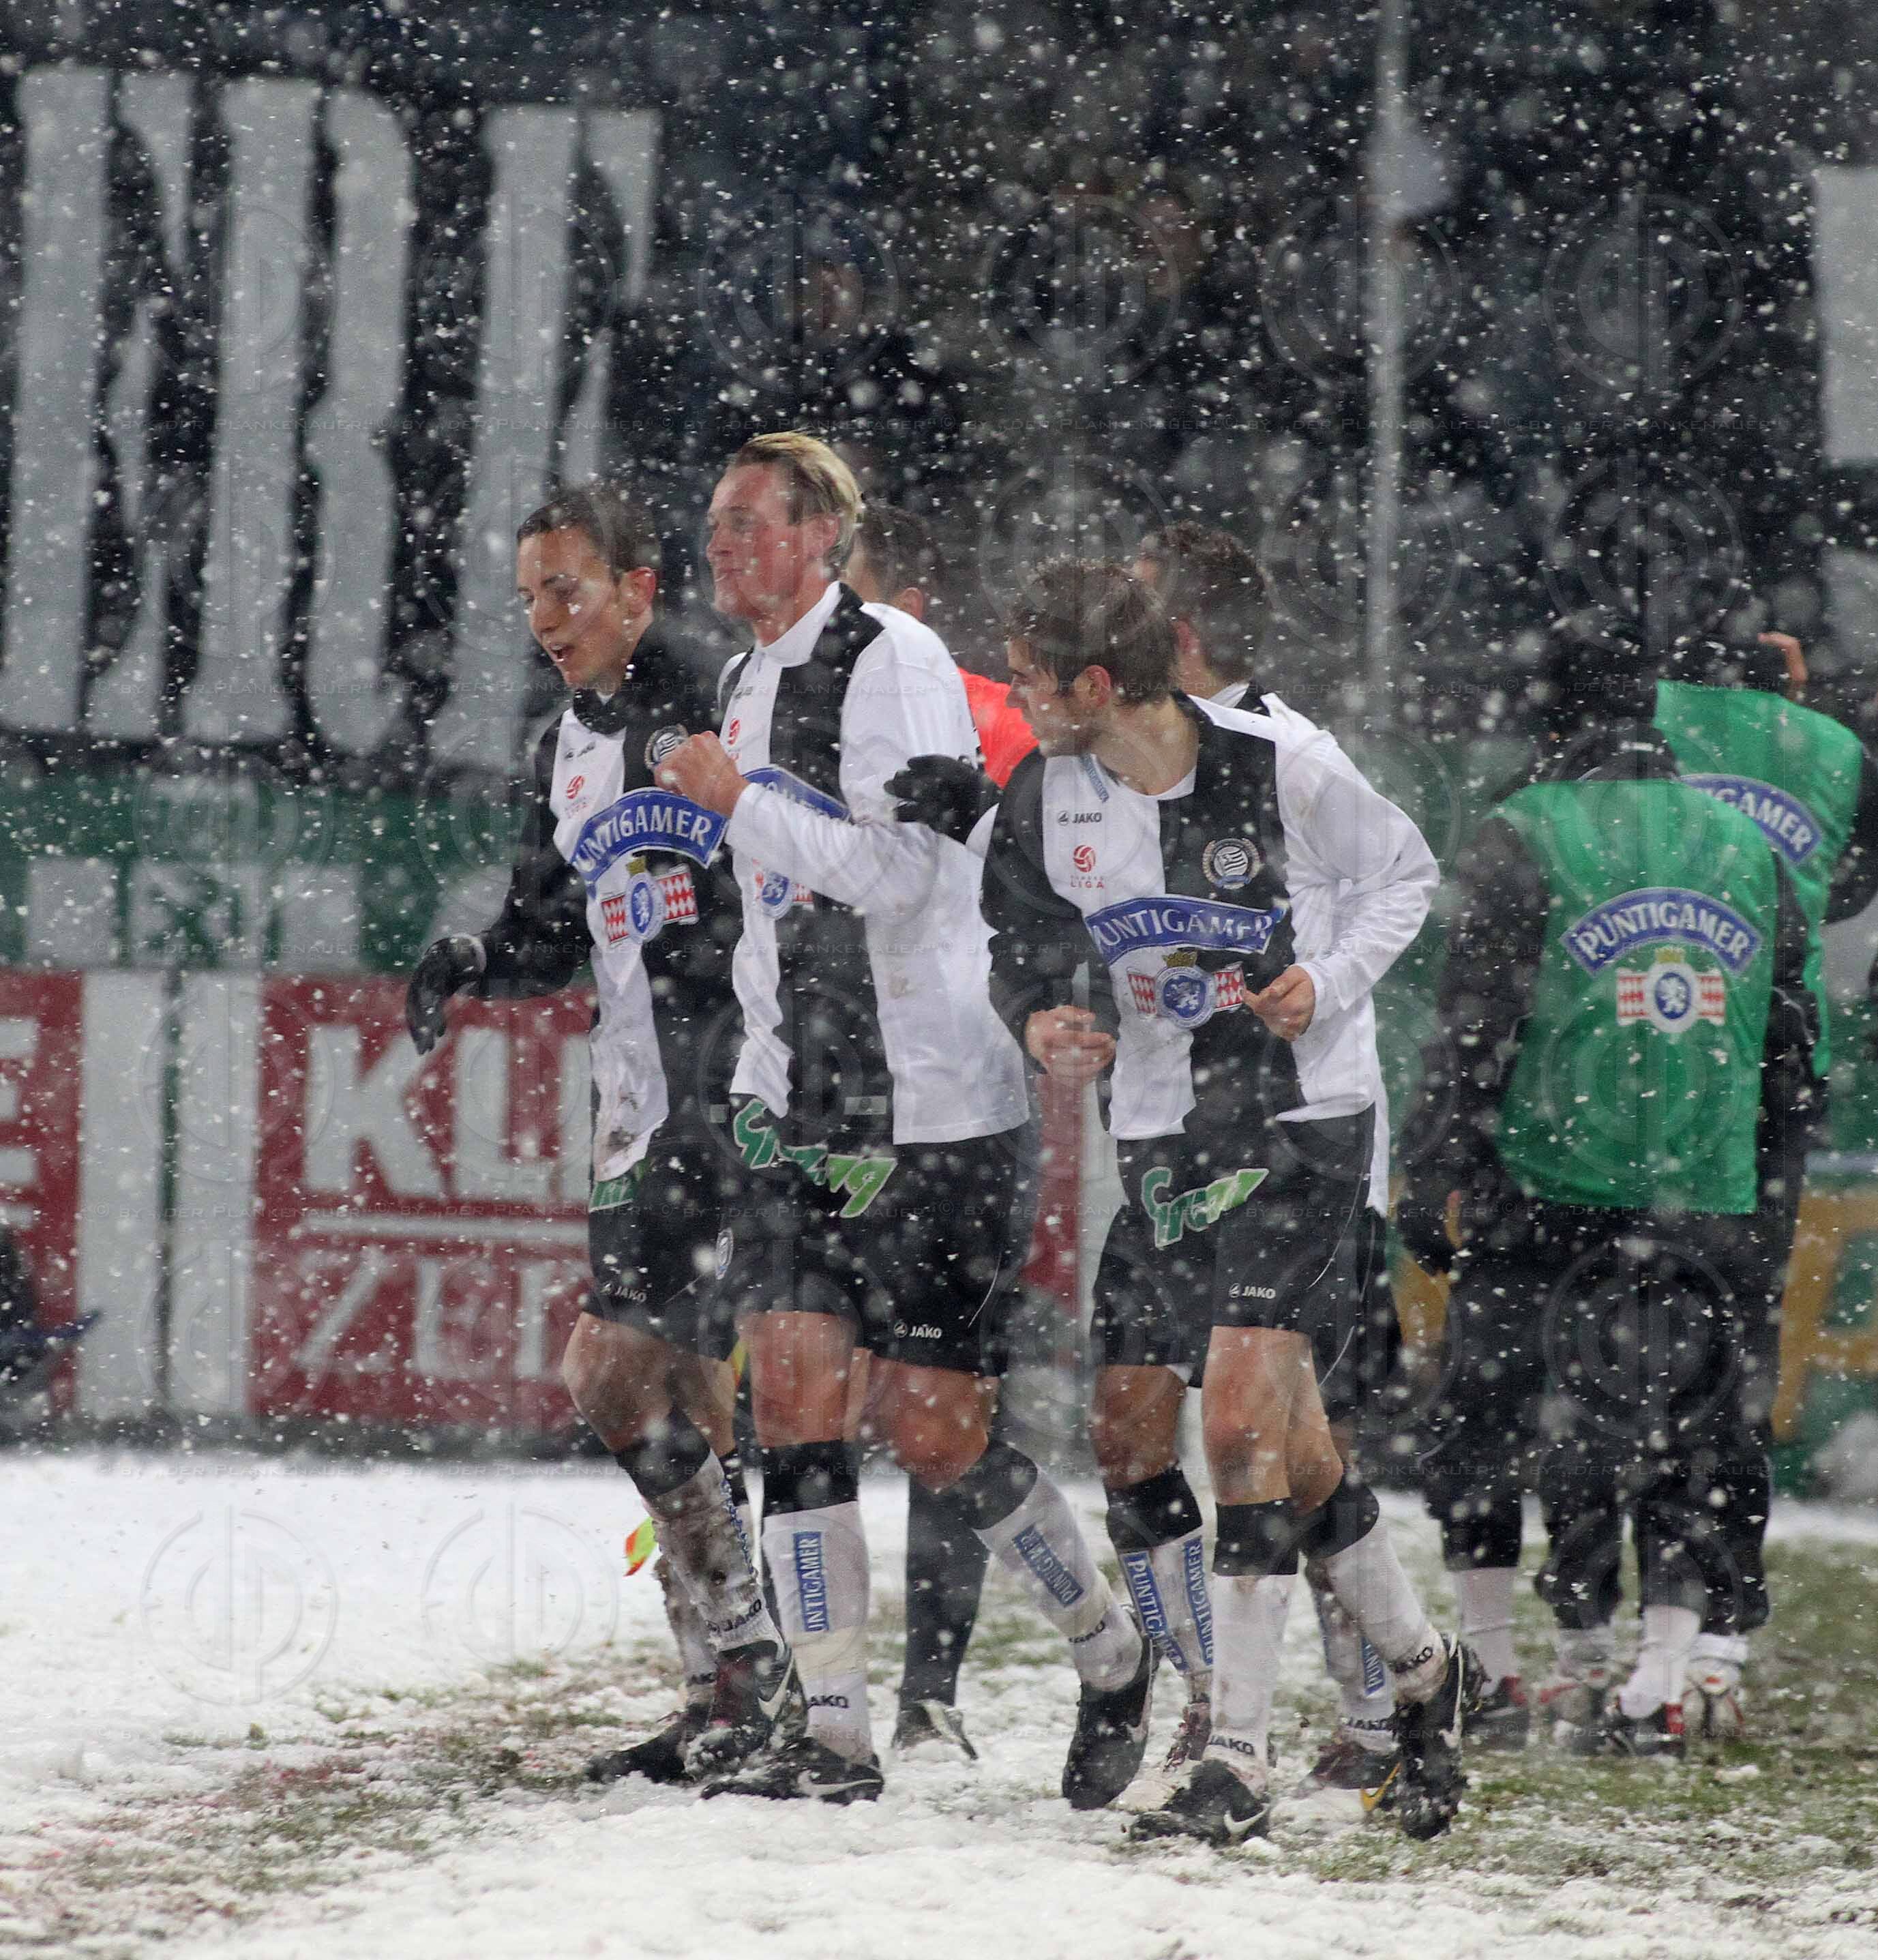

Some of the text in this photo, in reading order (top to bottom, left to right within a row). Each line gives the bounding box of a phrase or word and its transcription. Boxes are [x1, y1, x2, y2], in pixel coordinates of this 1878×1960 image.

[1072, 812, 1102, 824] JAKO
[573, 803, 712, 873] UNTIGAMER
[1575, 901, 1750, 960] PUNTIGAMER
[614, 1286, 648, 1303] JAKO
[1241, 1286, 1277, 1299] JAKO
[909, 1325, 942, 1339] JAKO
[807, 1695, 851, 1710] AKO
